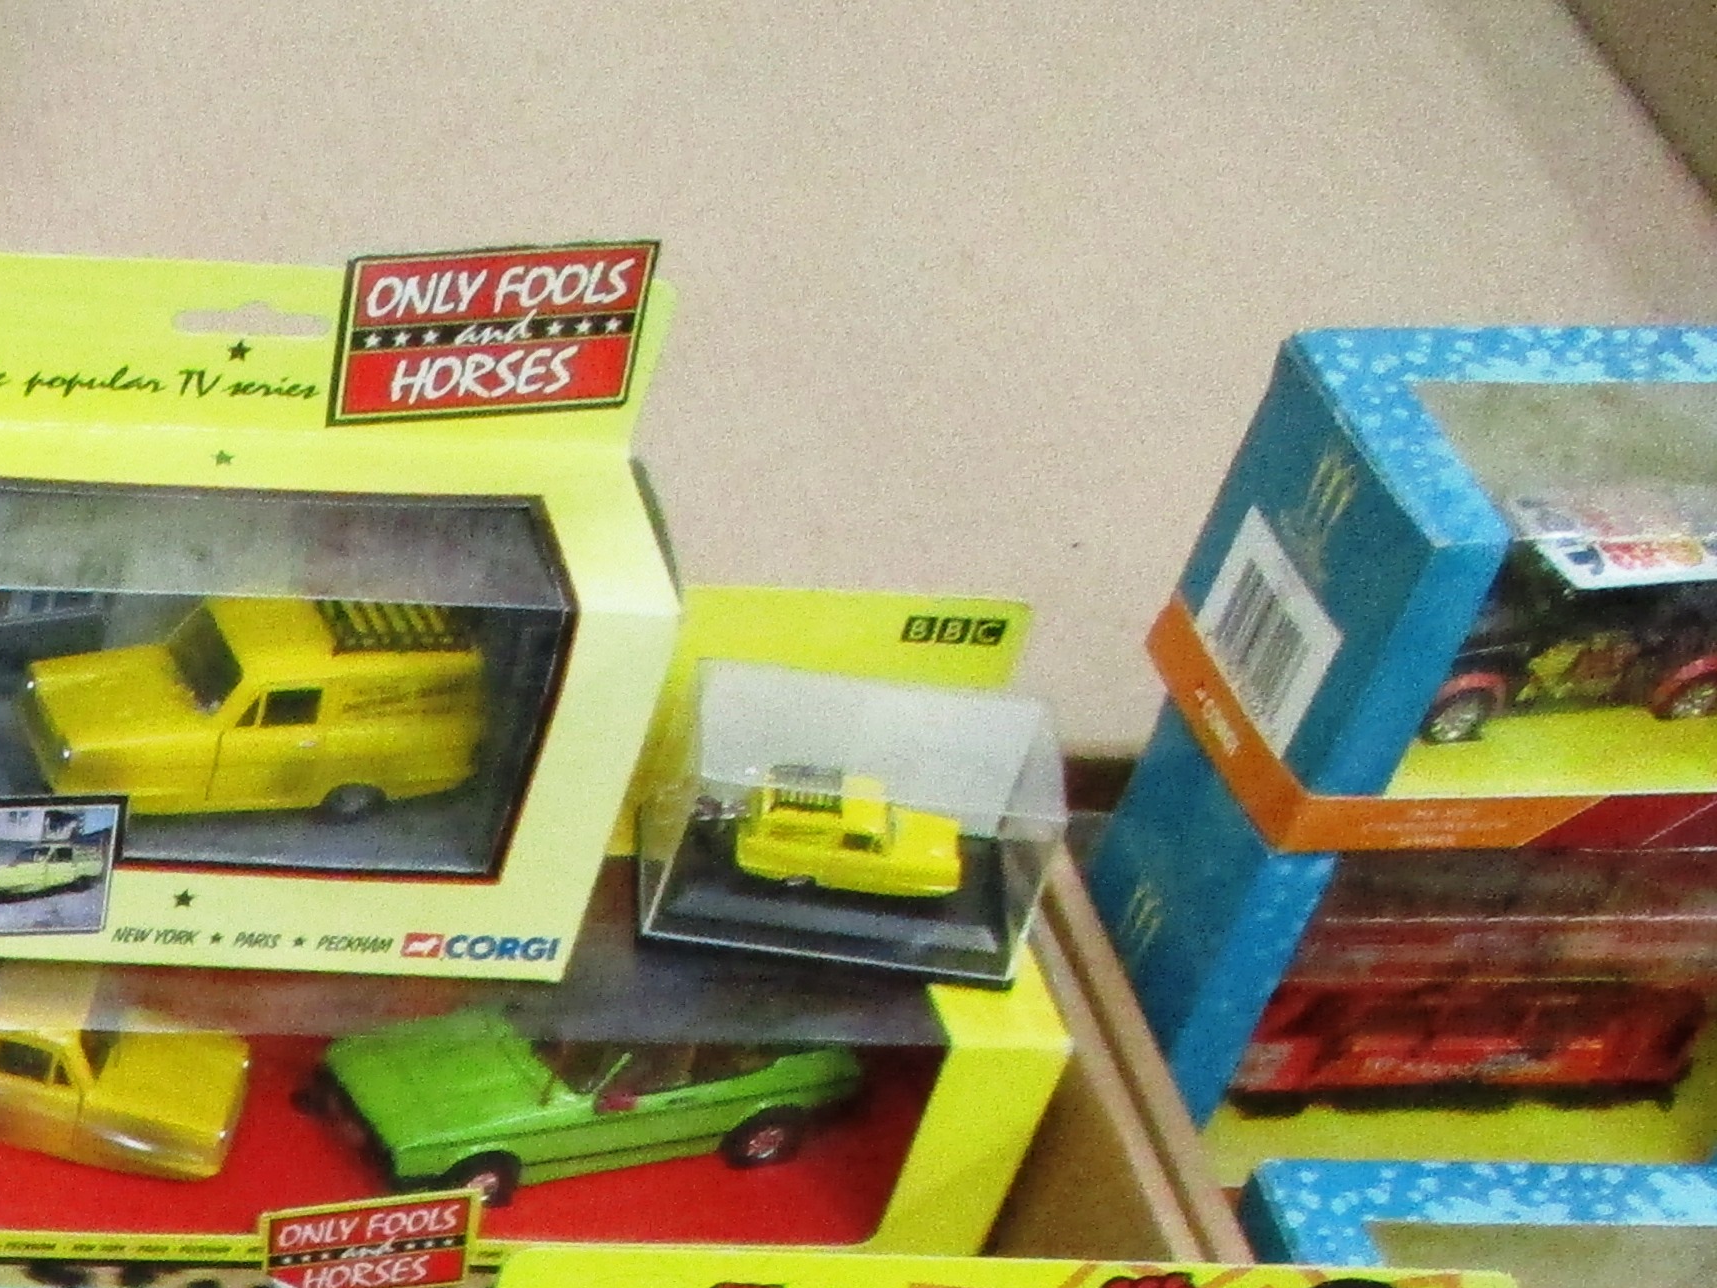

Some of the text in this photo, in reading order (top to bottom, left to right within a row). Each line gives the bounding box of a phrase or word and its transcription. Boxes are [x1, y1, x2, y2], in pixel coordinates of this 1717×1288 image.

[366, 258, 636, 319] ONLY FOOLS
[454, 309, 537, 346] and
[24, 366, 165, 398] popular
[179, 370, 222, 396] TV
[222, 377, 322, 402] series
[391, 346, 578, 405] HORSES
[903, 616, 1008, 646] BBC
[112, 927, 395, 955] NEW YORK PARIS PECKHAM
[442, 934, 563, 964] CORGI
[278, 1205, 459, 1248] ONLY FOOLS
